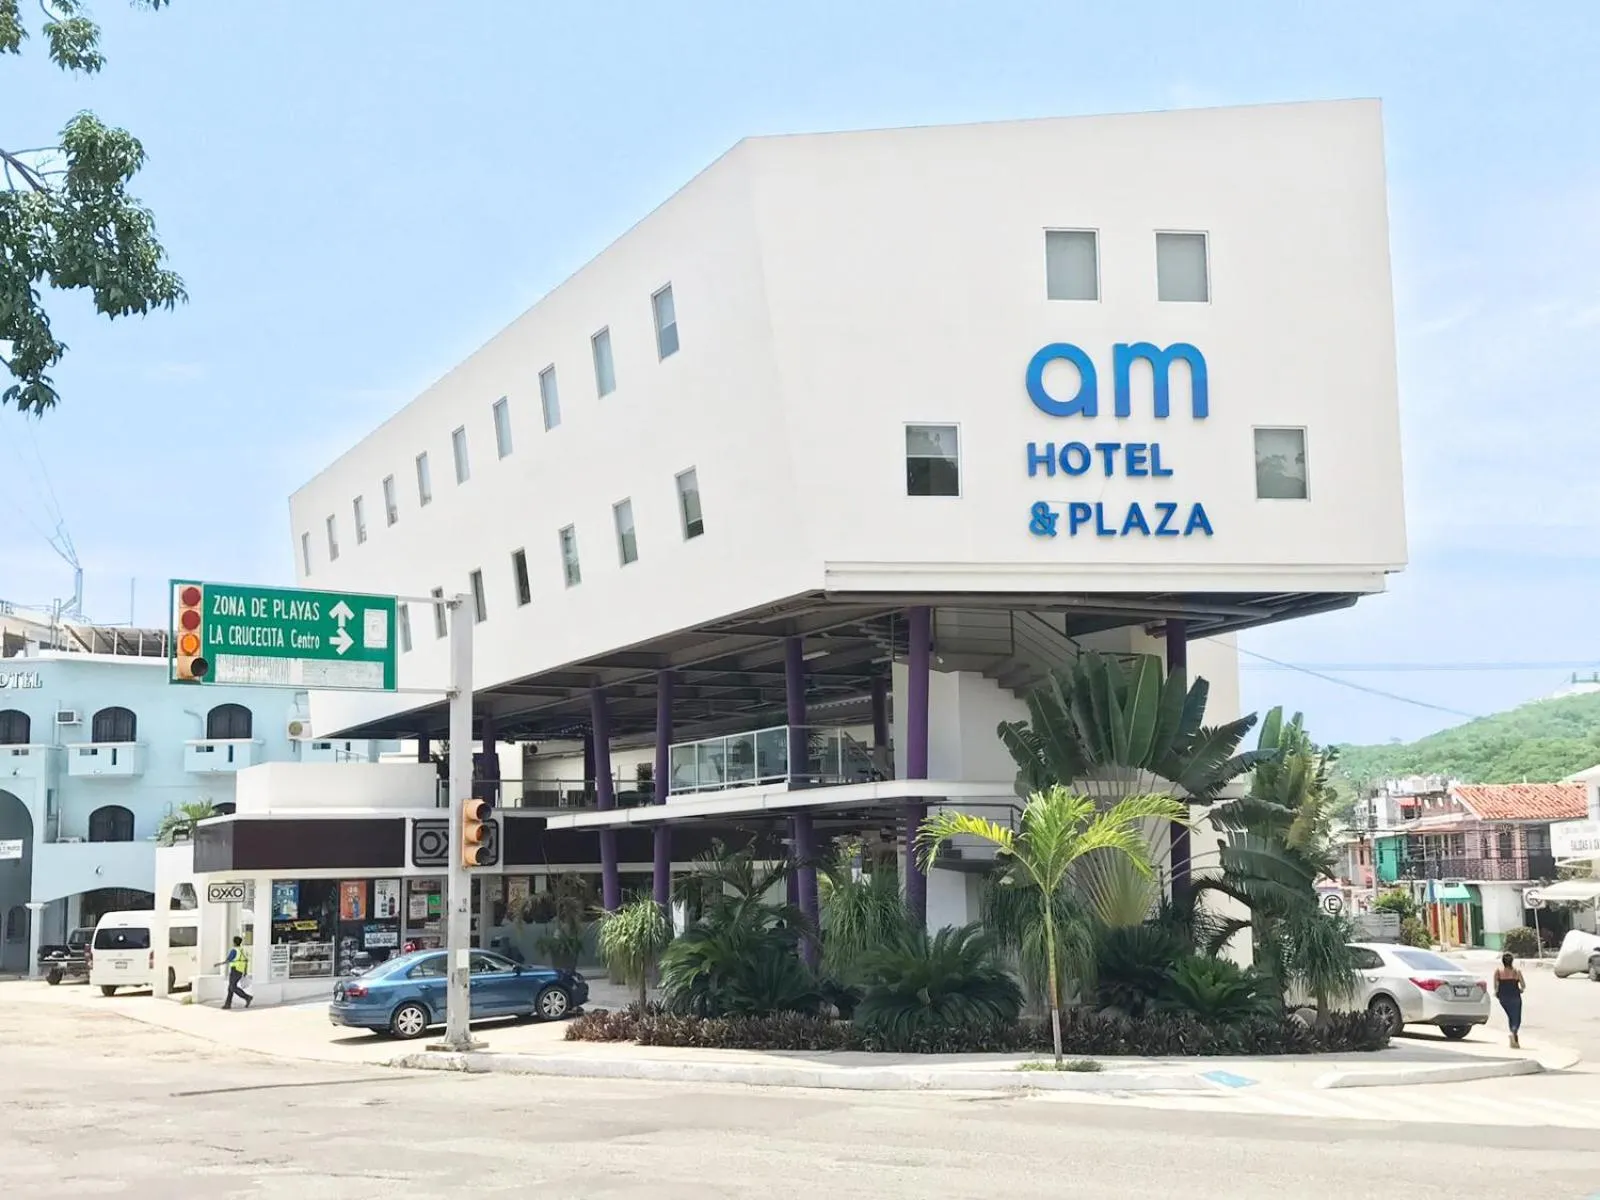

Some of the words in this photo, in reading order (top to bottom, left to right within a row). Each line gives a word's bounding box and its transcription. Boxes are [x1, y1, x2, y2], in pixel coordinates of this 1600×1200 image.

[1025, 342, 1209, 418] am
[1027, 441, 1173, 477] HOTEL
[1029, 501, 1059, 537] &
[1069, 501, 1214, 537] PLAZA
[213, 595, 246, 617] ZONA
[251, 597, 268, 618] DE
[273, 599, 320, 621] PLAYAS
[209, 624, 224, 645] LA
[228, 626, 284, 648] CRUCECITA
[290, 630, 320, 649] Centro
[210, 886, 243, 899] OXXO
[1328, 898, 1337, 911] E
